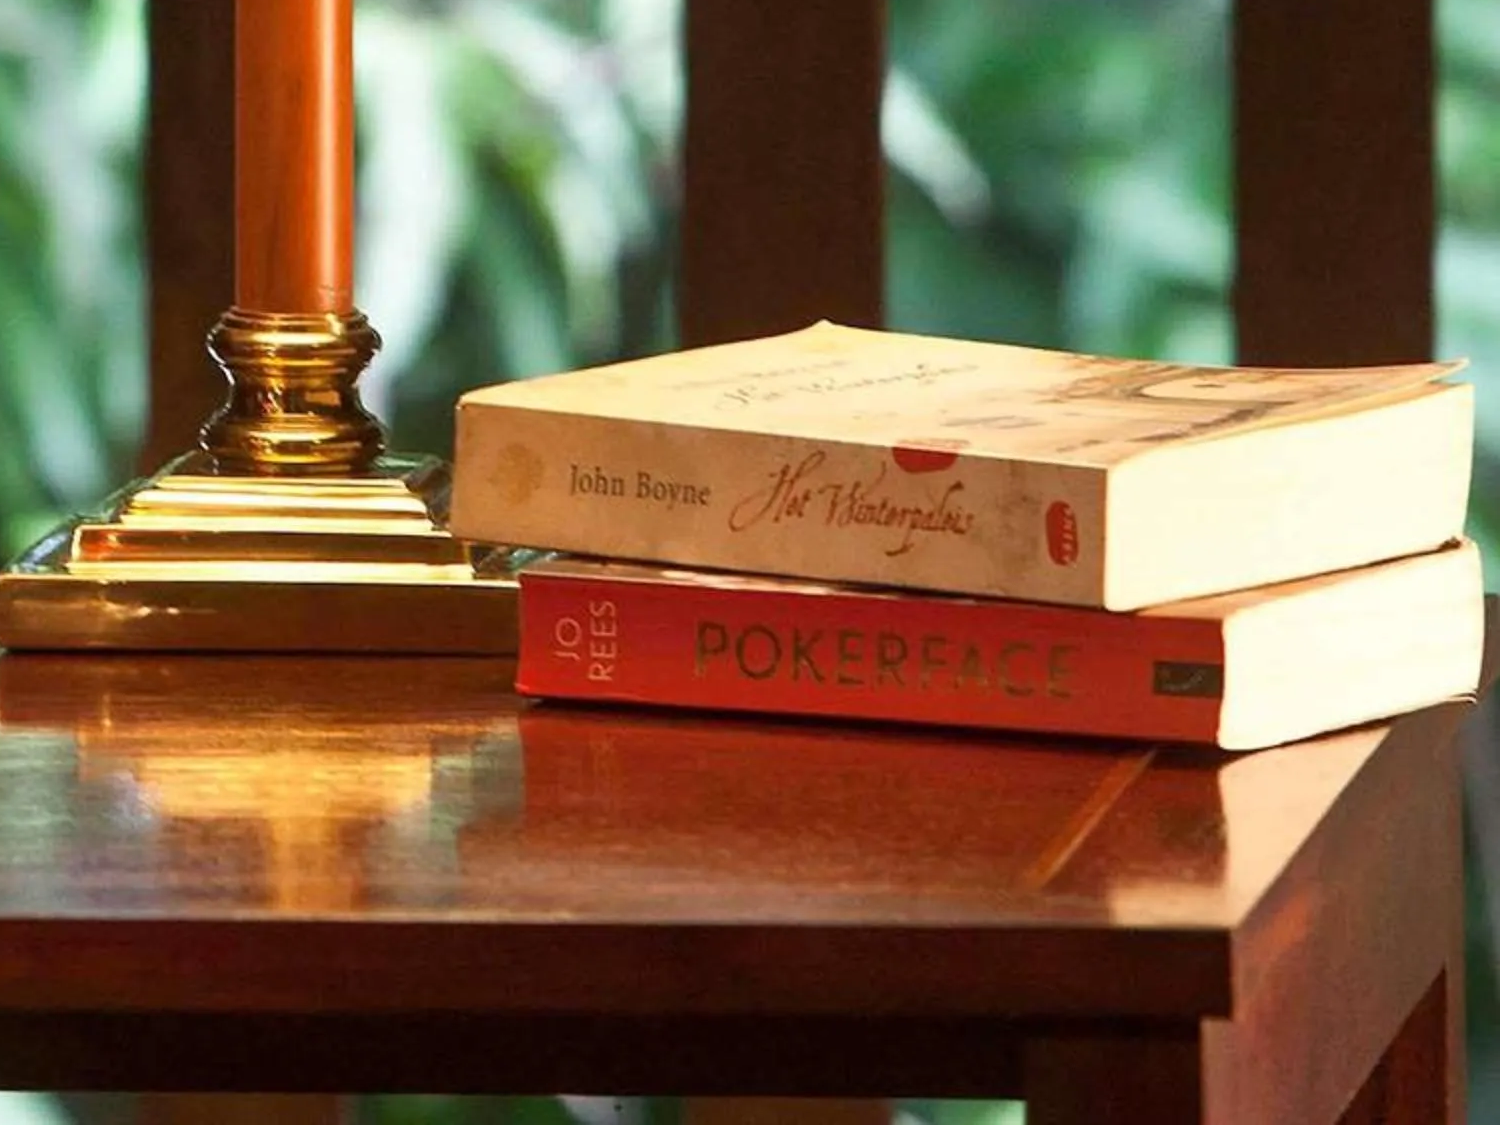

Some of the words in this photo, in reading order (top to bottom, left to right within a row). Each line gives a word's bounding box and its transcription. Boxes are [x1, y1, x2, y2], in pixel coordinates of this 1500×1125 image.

[569, 463, 626, 497] John
[635, 471, 713, 511] Boyne
[727, 449, 827, 534] Het
[554, 616, 583, 662] JO
[587, 599, 618, 683] REES
[693, 619, 1081, 699] POKERFACE
